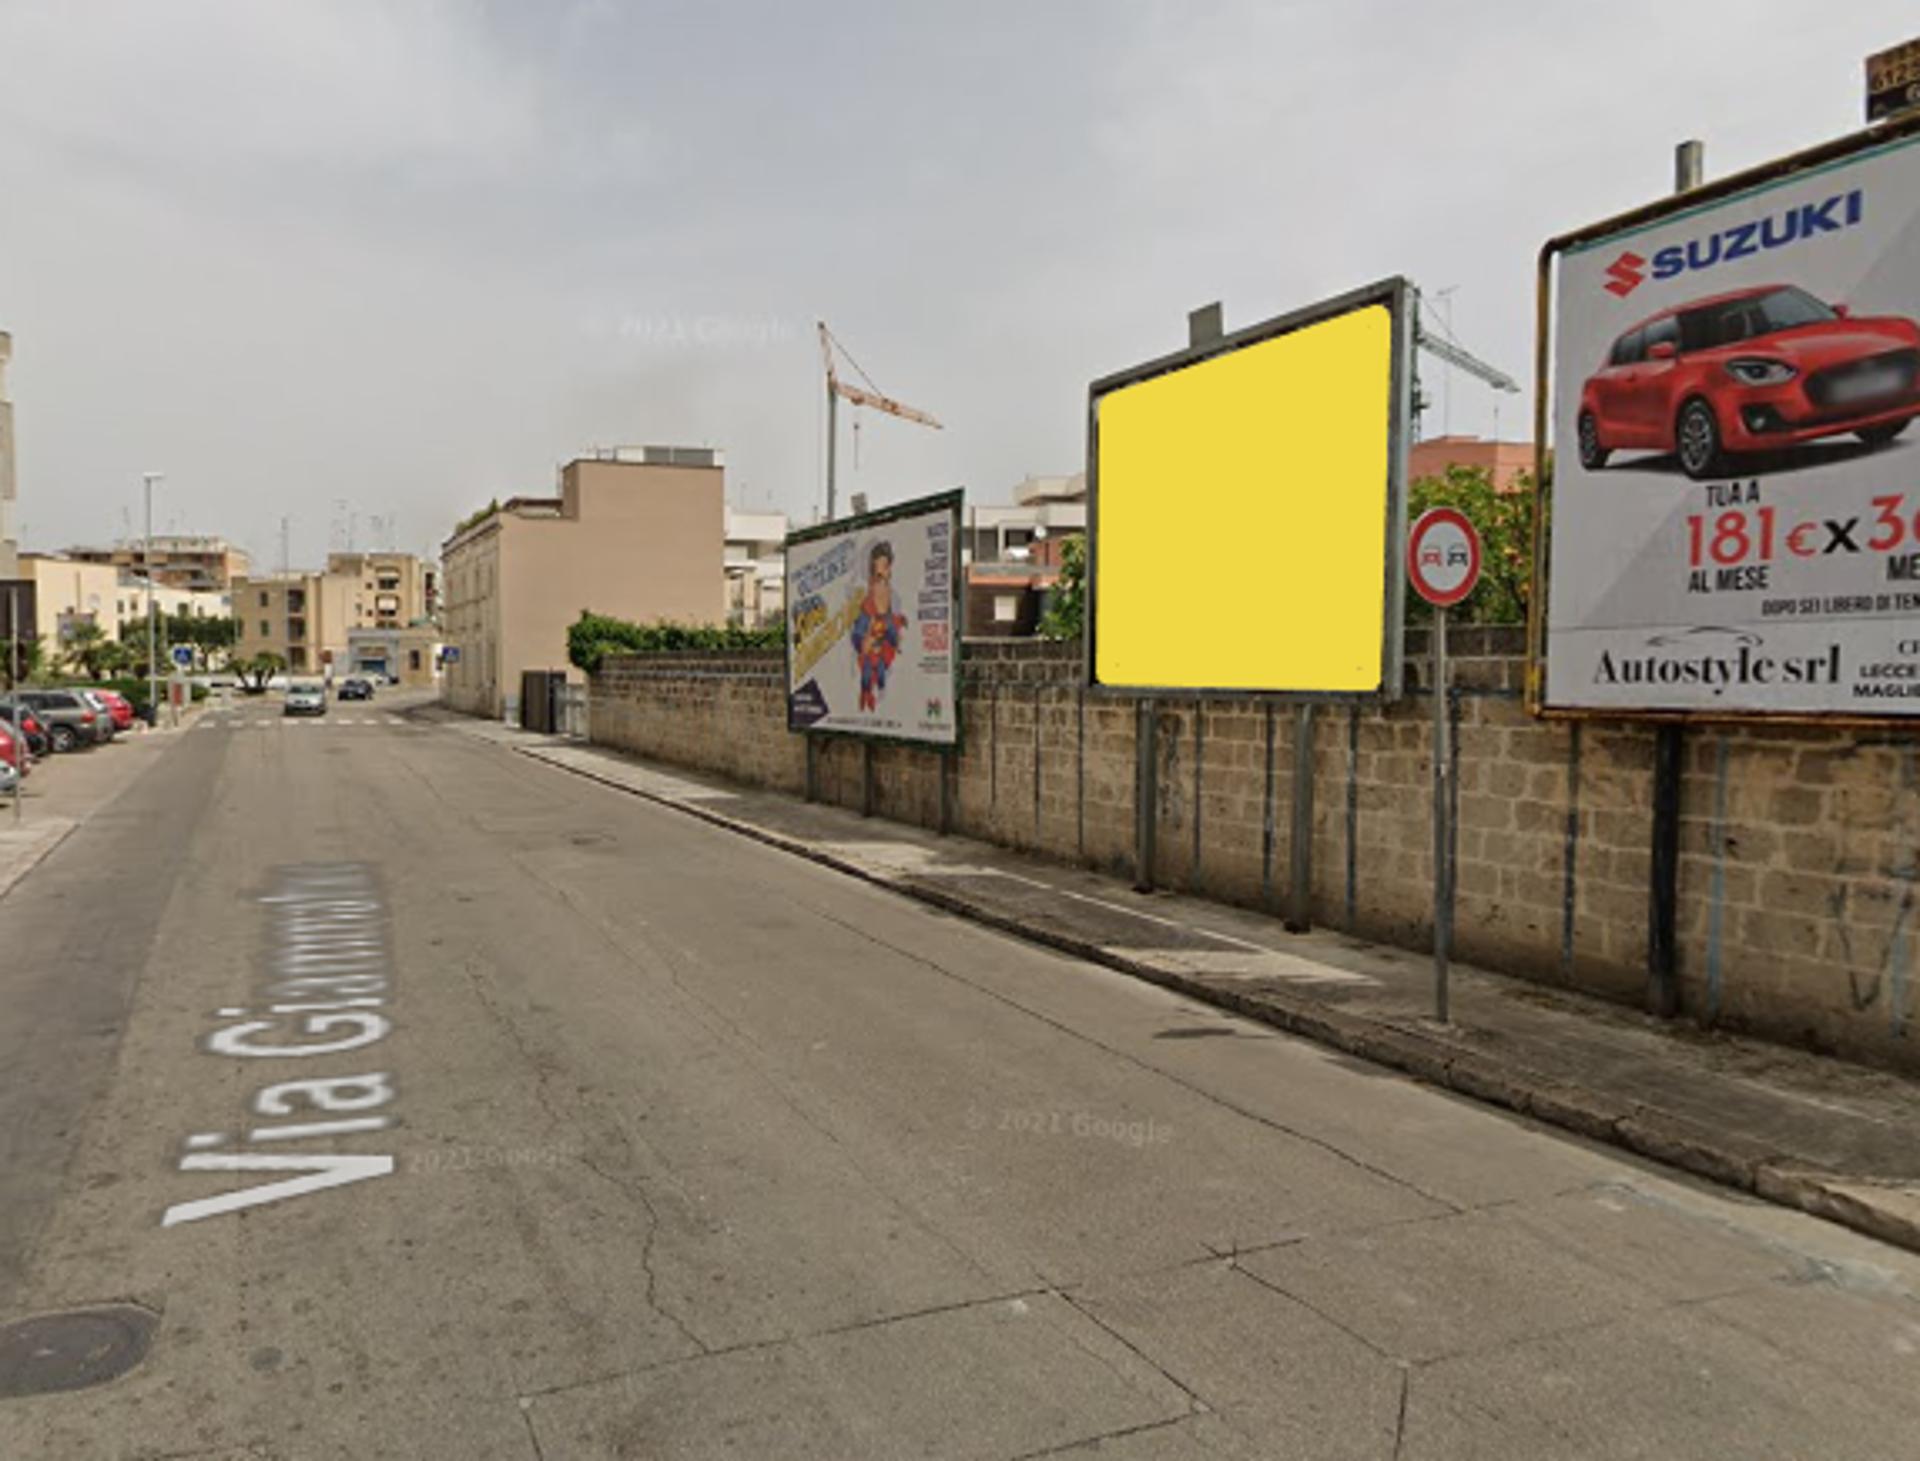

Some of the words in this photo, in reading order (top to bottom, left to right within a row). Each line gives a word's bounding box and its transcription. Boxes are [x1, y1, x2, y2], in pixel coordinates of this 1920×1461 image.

[1651, 190, 1863, 280] SUZUKI
[1705, 482, 1741, 507] TUA
[1745, 479, 1761, 503] A
[1867, 493, 1920, 551] 3
[1687, 567, 1711, 594] AL
[1715, 564, 1769, 592] MESE
[1594, 645, 1775, 696] Autostyle
[1782, 643, 1841, 684] srl
